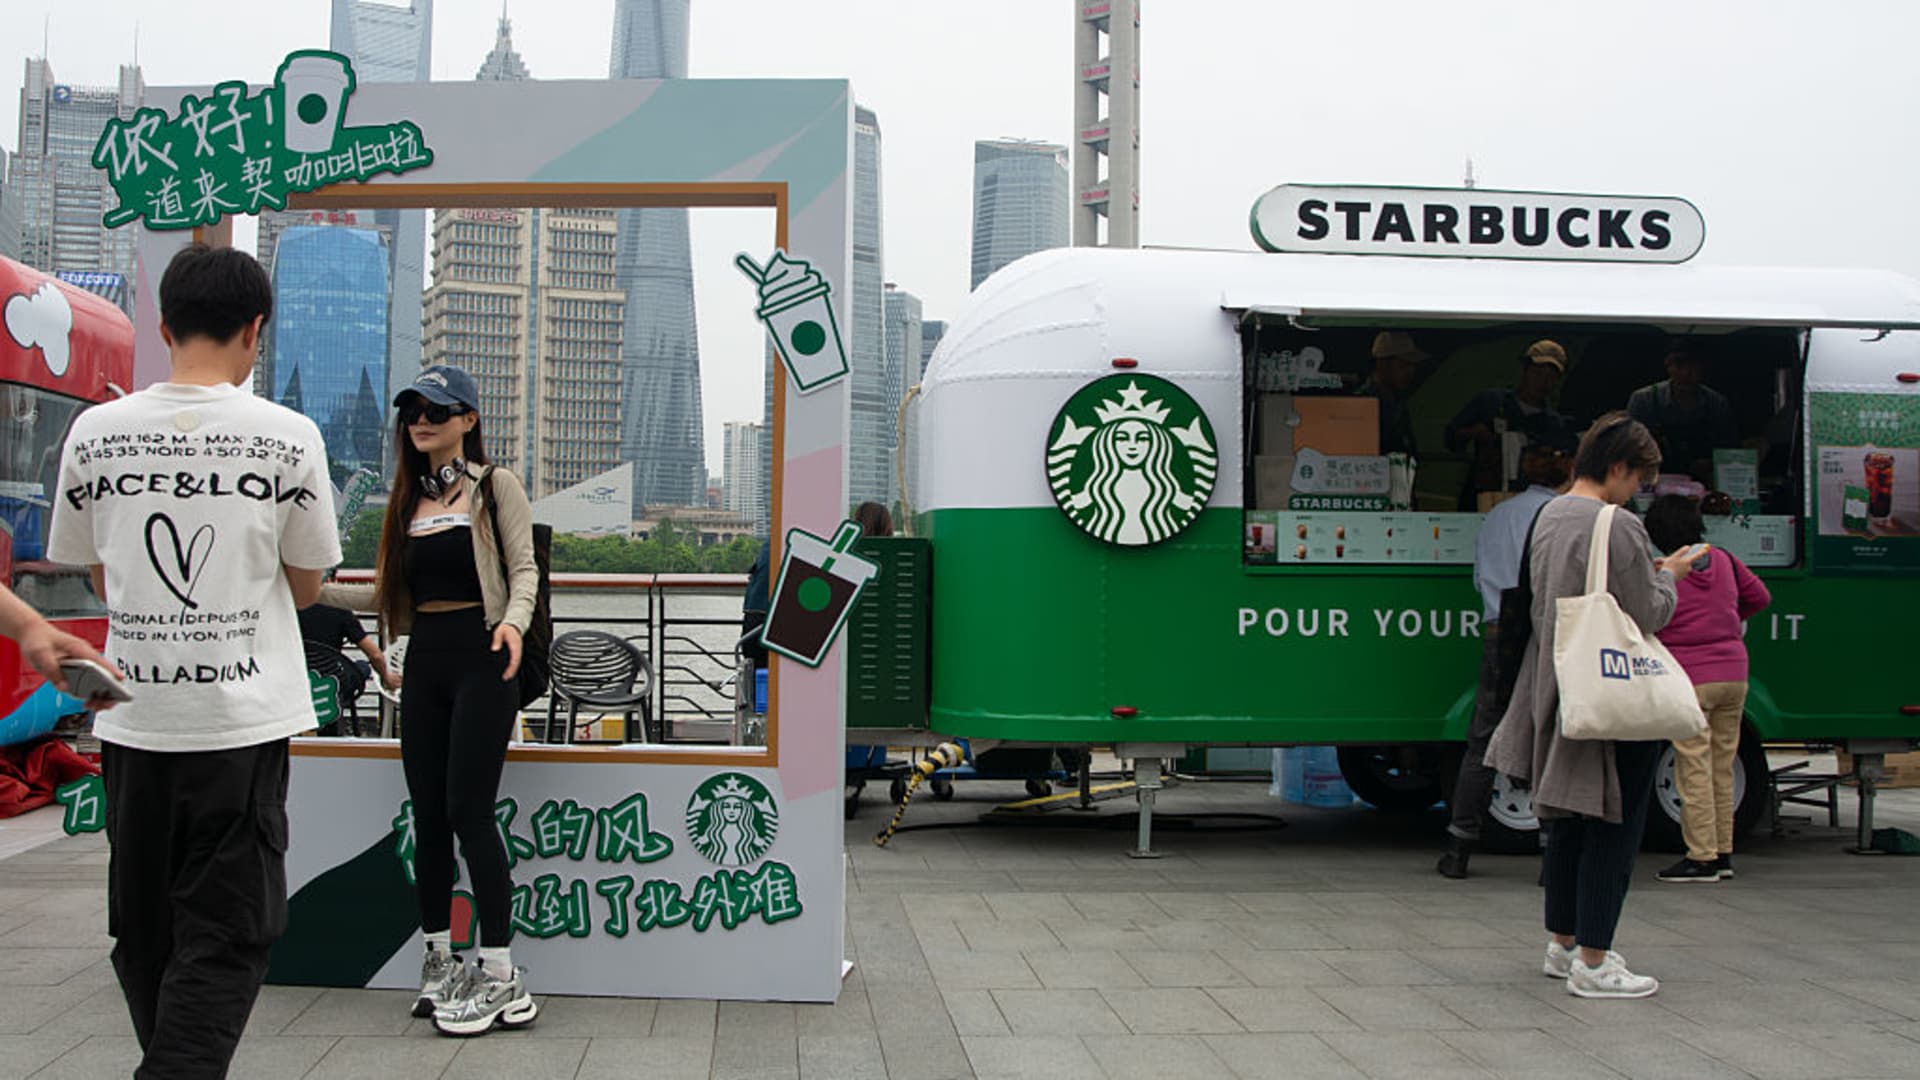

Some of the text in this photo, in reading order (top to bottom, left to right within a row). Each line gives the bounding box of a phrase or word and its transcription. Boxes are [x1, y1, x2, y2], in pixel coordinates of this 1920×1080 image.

[1297, 199, 1672, 250] STARBUCKS
[136, 433, 165, 445] 162
[171, 434, 188, 445] M
[252, 436, 287, 451] 305
[291, 445, 304, 456] M
[145, 446, 197, 457] NORD
[1293, 497, 1384, 511] STARBUCKS
[1238, 607, 1349, 637] POUR
[1373, 608, 1481, 638] YOUR
[1771, 613, 1806, 641] IT
[1603, 653, 1628, 676] M
